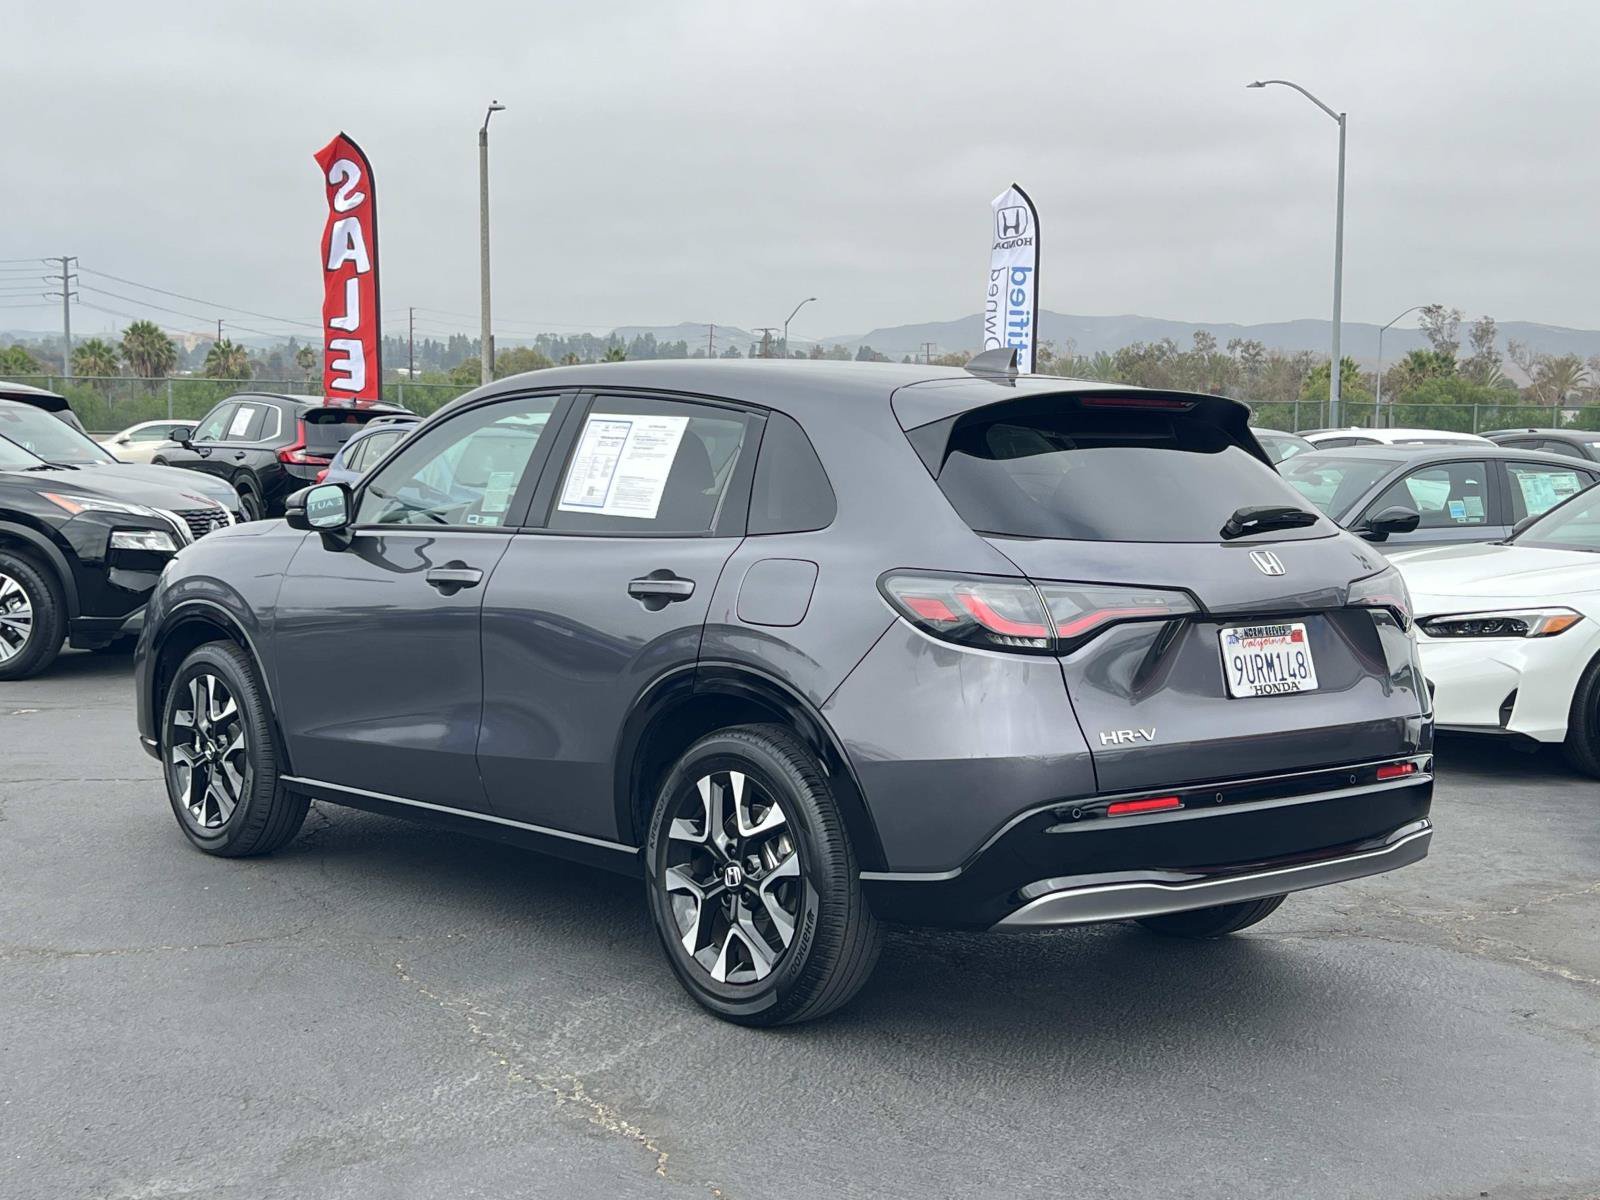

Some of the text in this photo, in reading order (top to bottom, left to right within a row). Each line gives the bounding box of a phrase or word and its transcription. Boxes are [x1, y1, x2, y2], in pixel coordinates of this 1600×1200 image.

[1243, 625, 1286, 638] NORM REEVES
[1234, 651, 1307, 686] 9URM148
[1254, 681, 1301, 696] HONDA
[1099, 728, 1156, 746] HR-V
